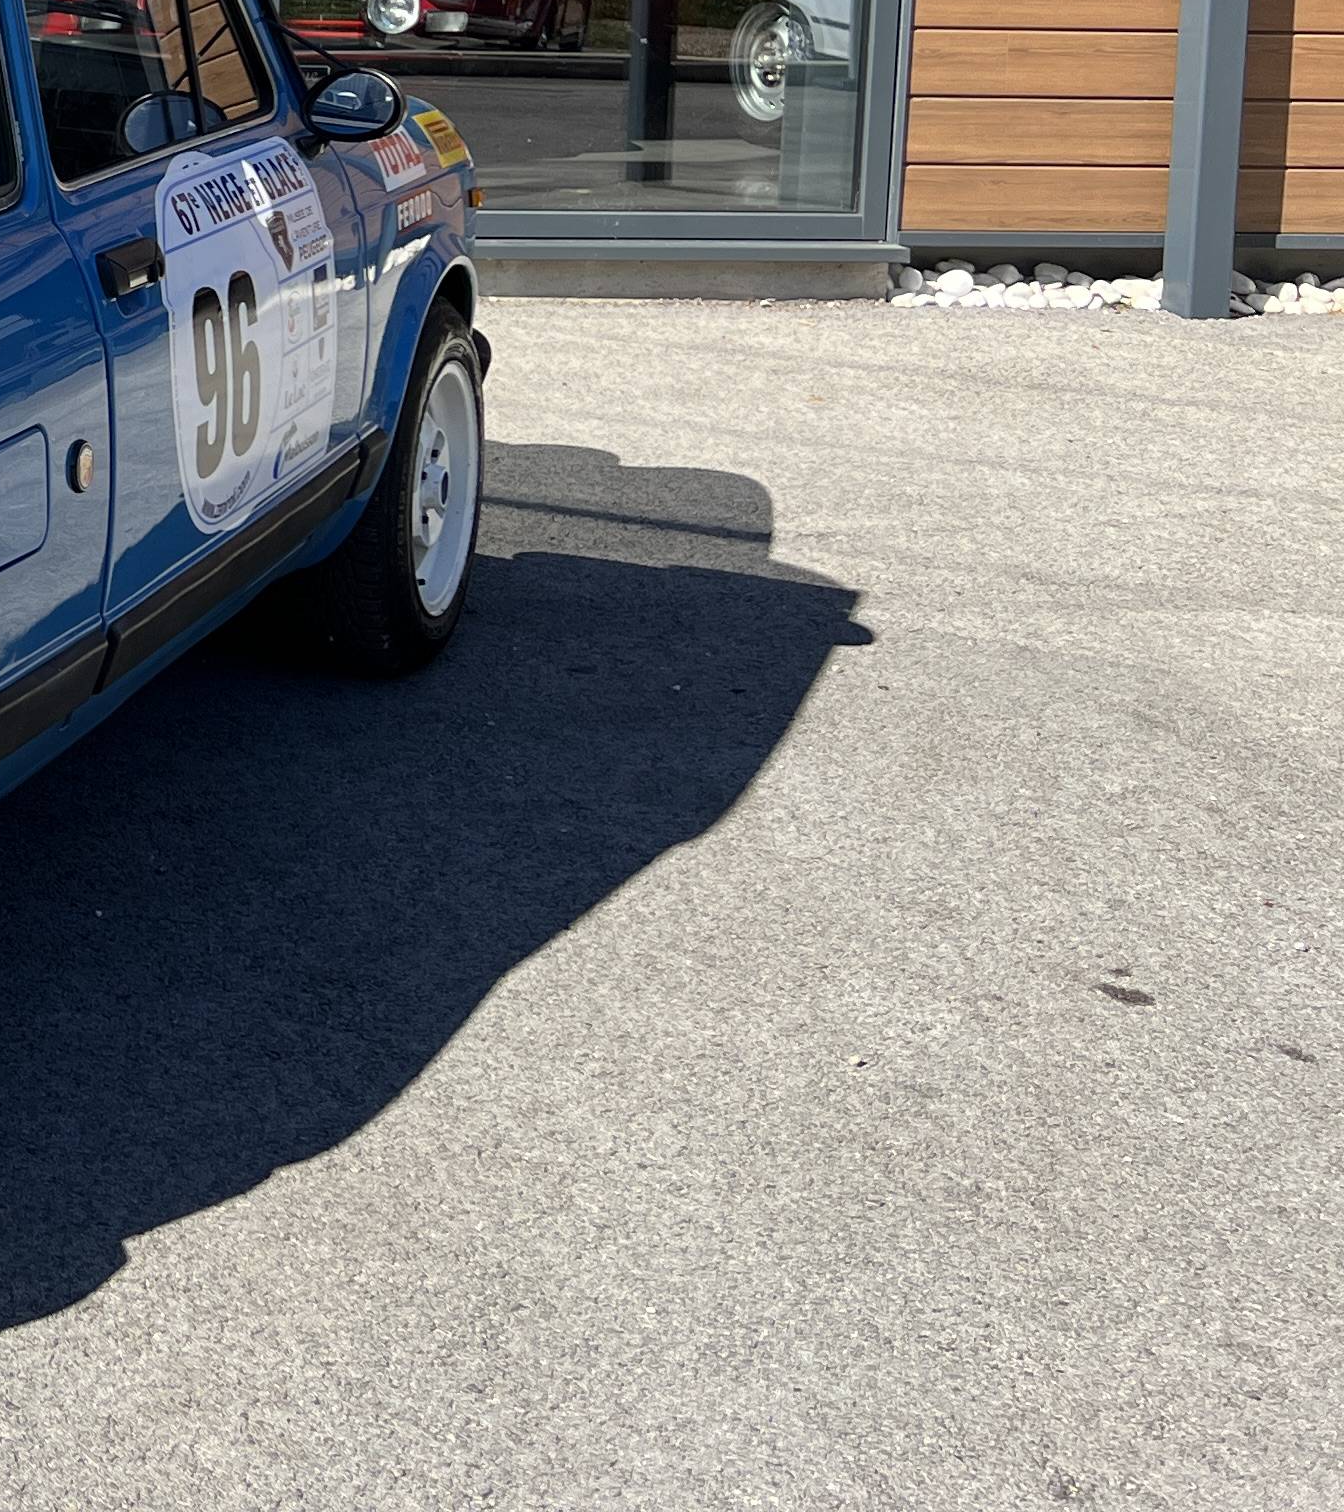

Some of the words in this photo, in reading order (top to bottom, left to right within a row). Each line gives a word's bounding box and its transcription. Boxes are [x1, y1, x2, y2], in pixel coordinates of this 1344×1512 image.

[253, 152, 304, 201] GLACE
[371, 130, 422, 178] TOTAL
[194, 172, 252, 225] NEIGE
[245, 178, 265, 206] ET
[193, 270, 261, 479] 96
